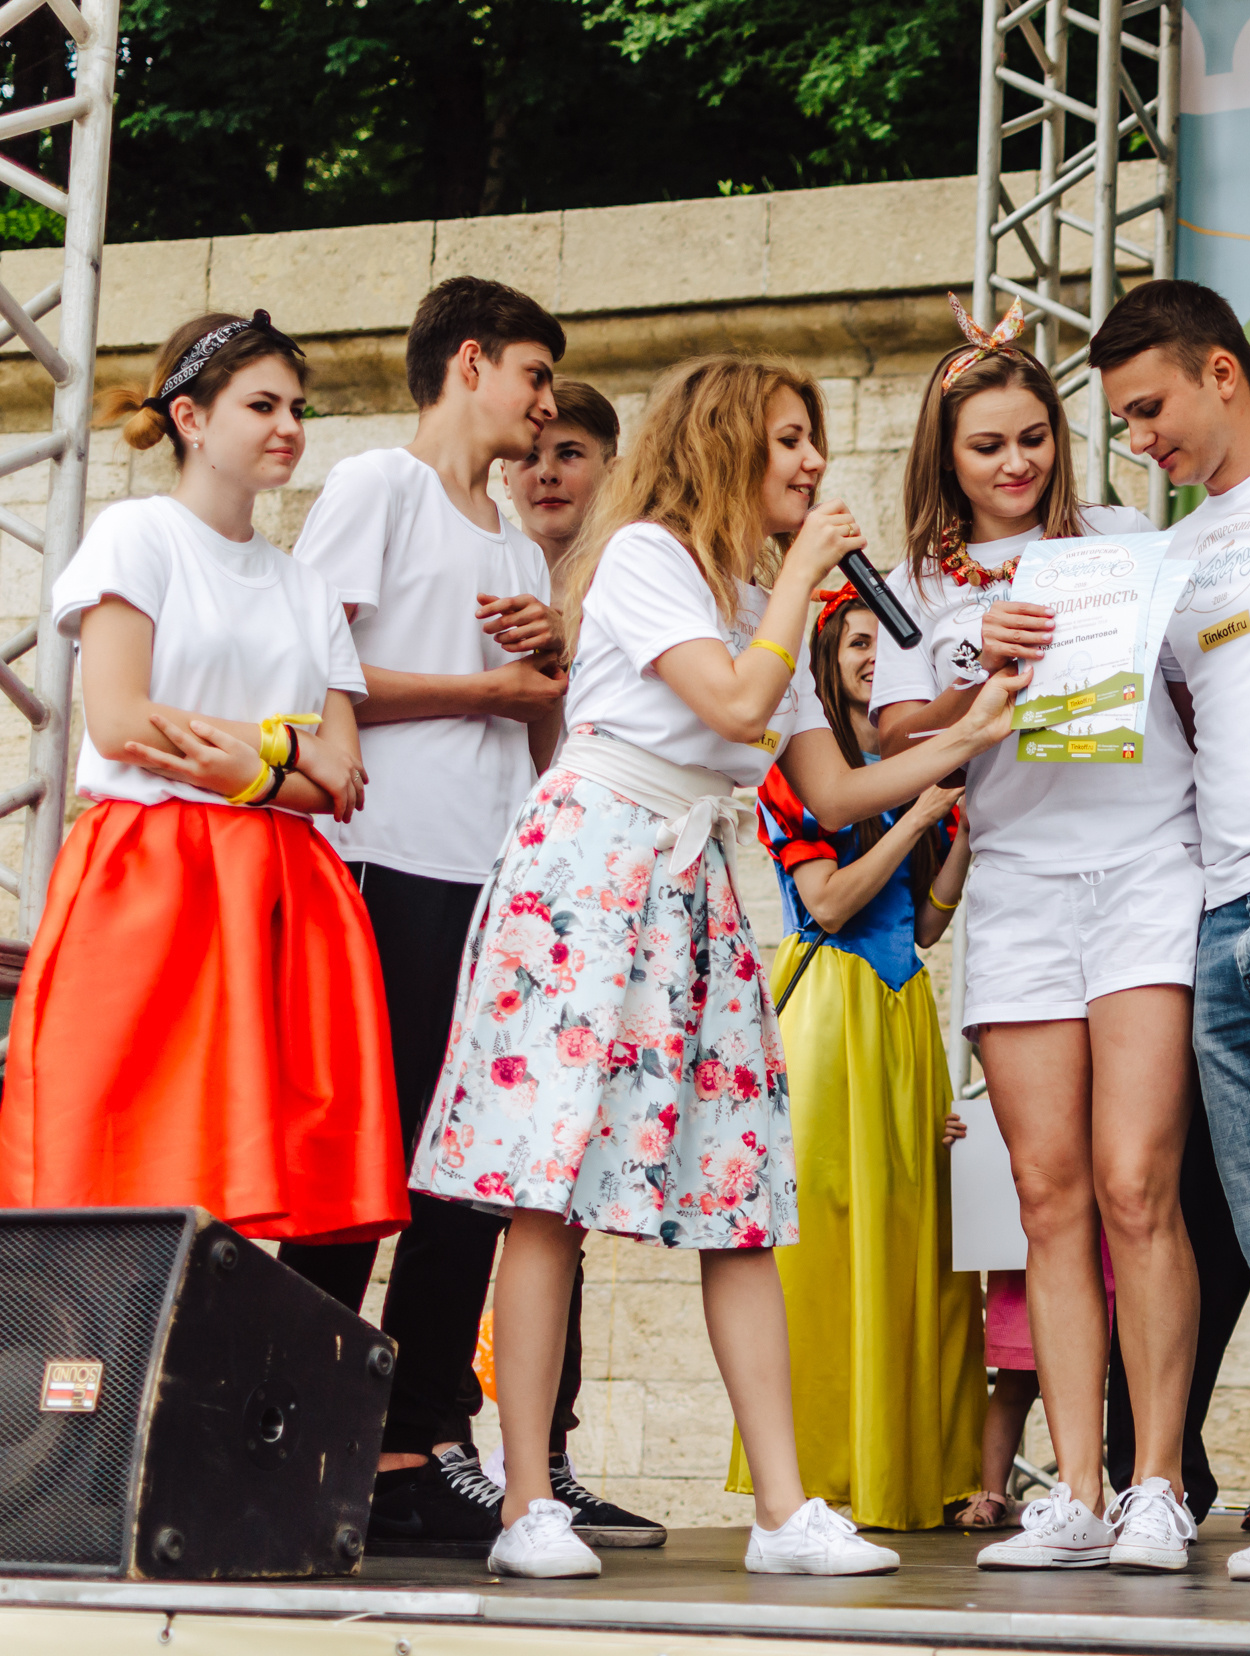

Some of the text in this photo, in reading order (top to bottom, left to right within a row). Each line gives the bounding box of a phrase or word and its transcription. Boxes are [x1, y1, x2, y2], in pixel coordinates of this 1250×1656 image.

[1043, 589, 1139, 615] ГОДАРНОСТЬ
[1038, 628, 1118, 652] настасии Политовой
[1202, 620, 1248, 645] Tinkoff.ru
[1070, 696, 1094, 707] Tinkoff.ru
[1071, 743, 1094, 752] Tinkoff.ru
[52, 1366, 98, 1382] SOUND
